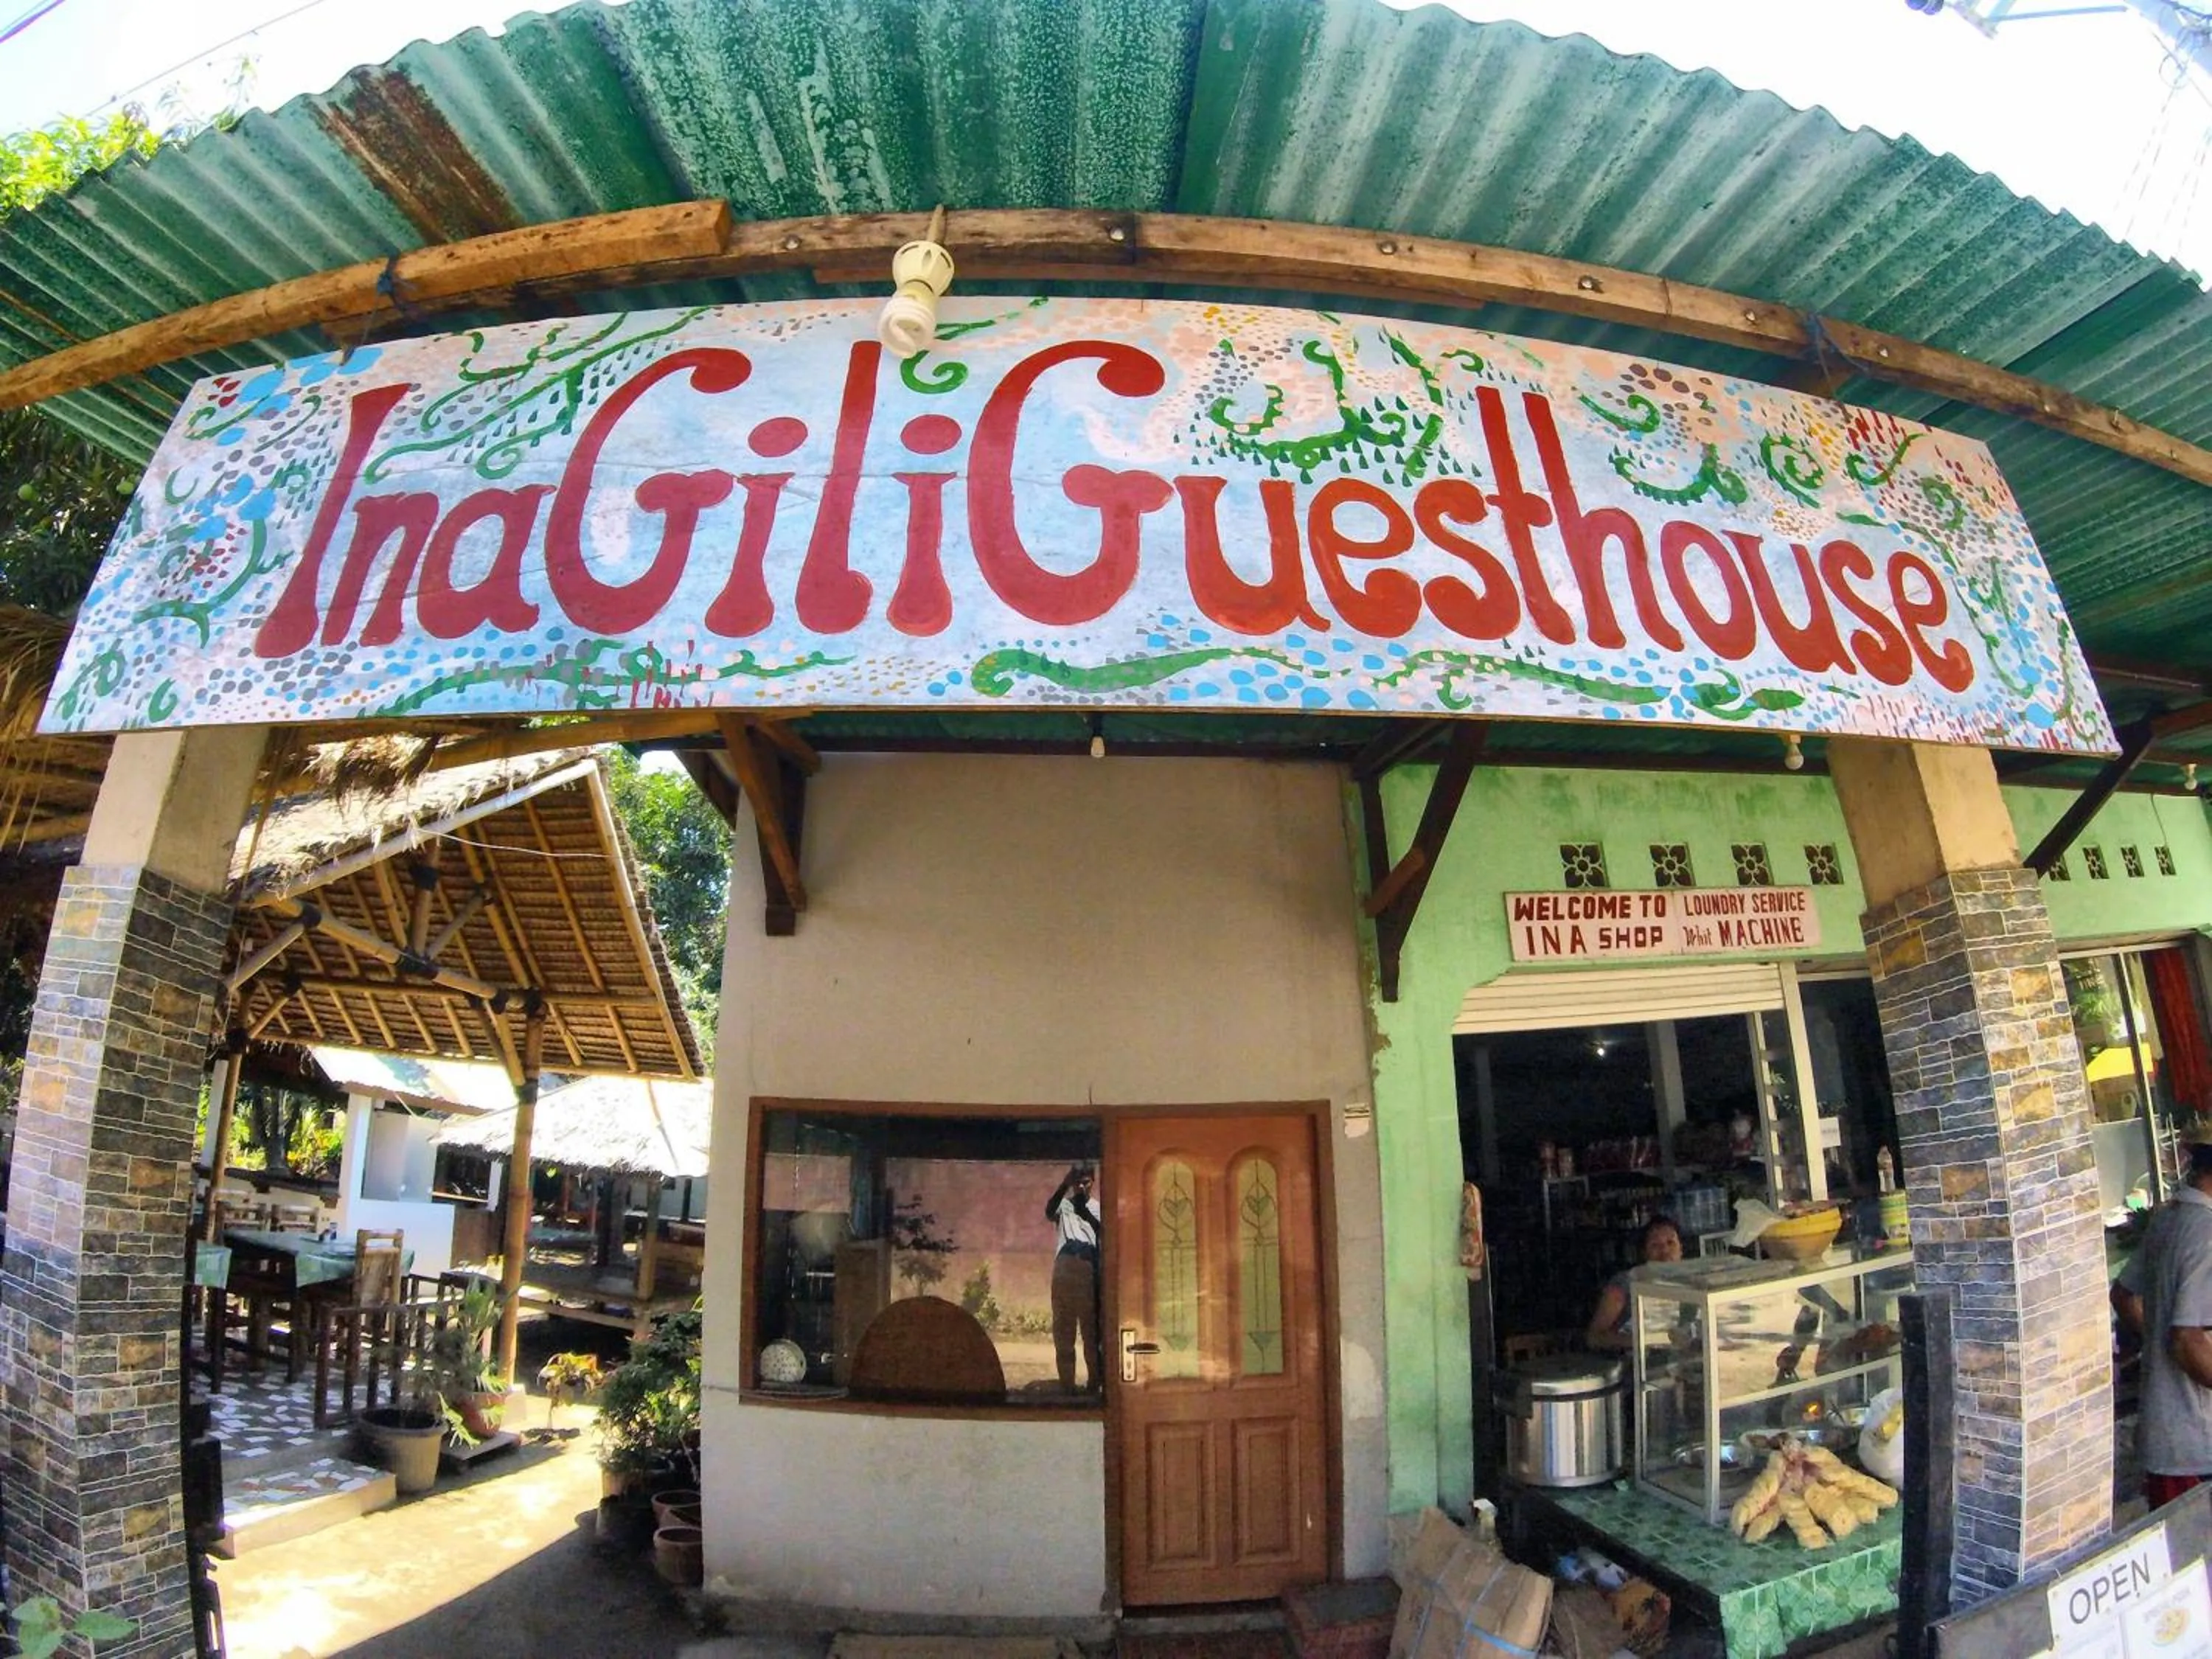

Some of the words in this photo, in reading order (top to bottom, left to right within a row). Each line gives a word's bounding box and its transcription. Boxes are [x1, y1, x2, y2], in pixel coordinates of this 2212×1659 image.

[1514, 897, 1631, 921] WELCOME
[1639, 895, 1666, 918] TO
[1684, 894, 1745, 916] LOUNDRY
[1752, 891, 1806, 913] SERVICE
[1599, 925, 1663, 949] SHOP
[1717, 917, 1804, 947] MACHINE
[2069, 1552, 2151, 1624] OPEN
